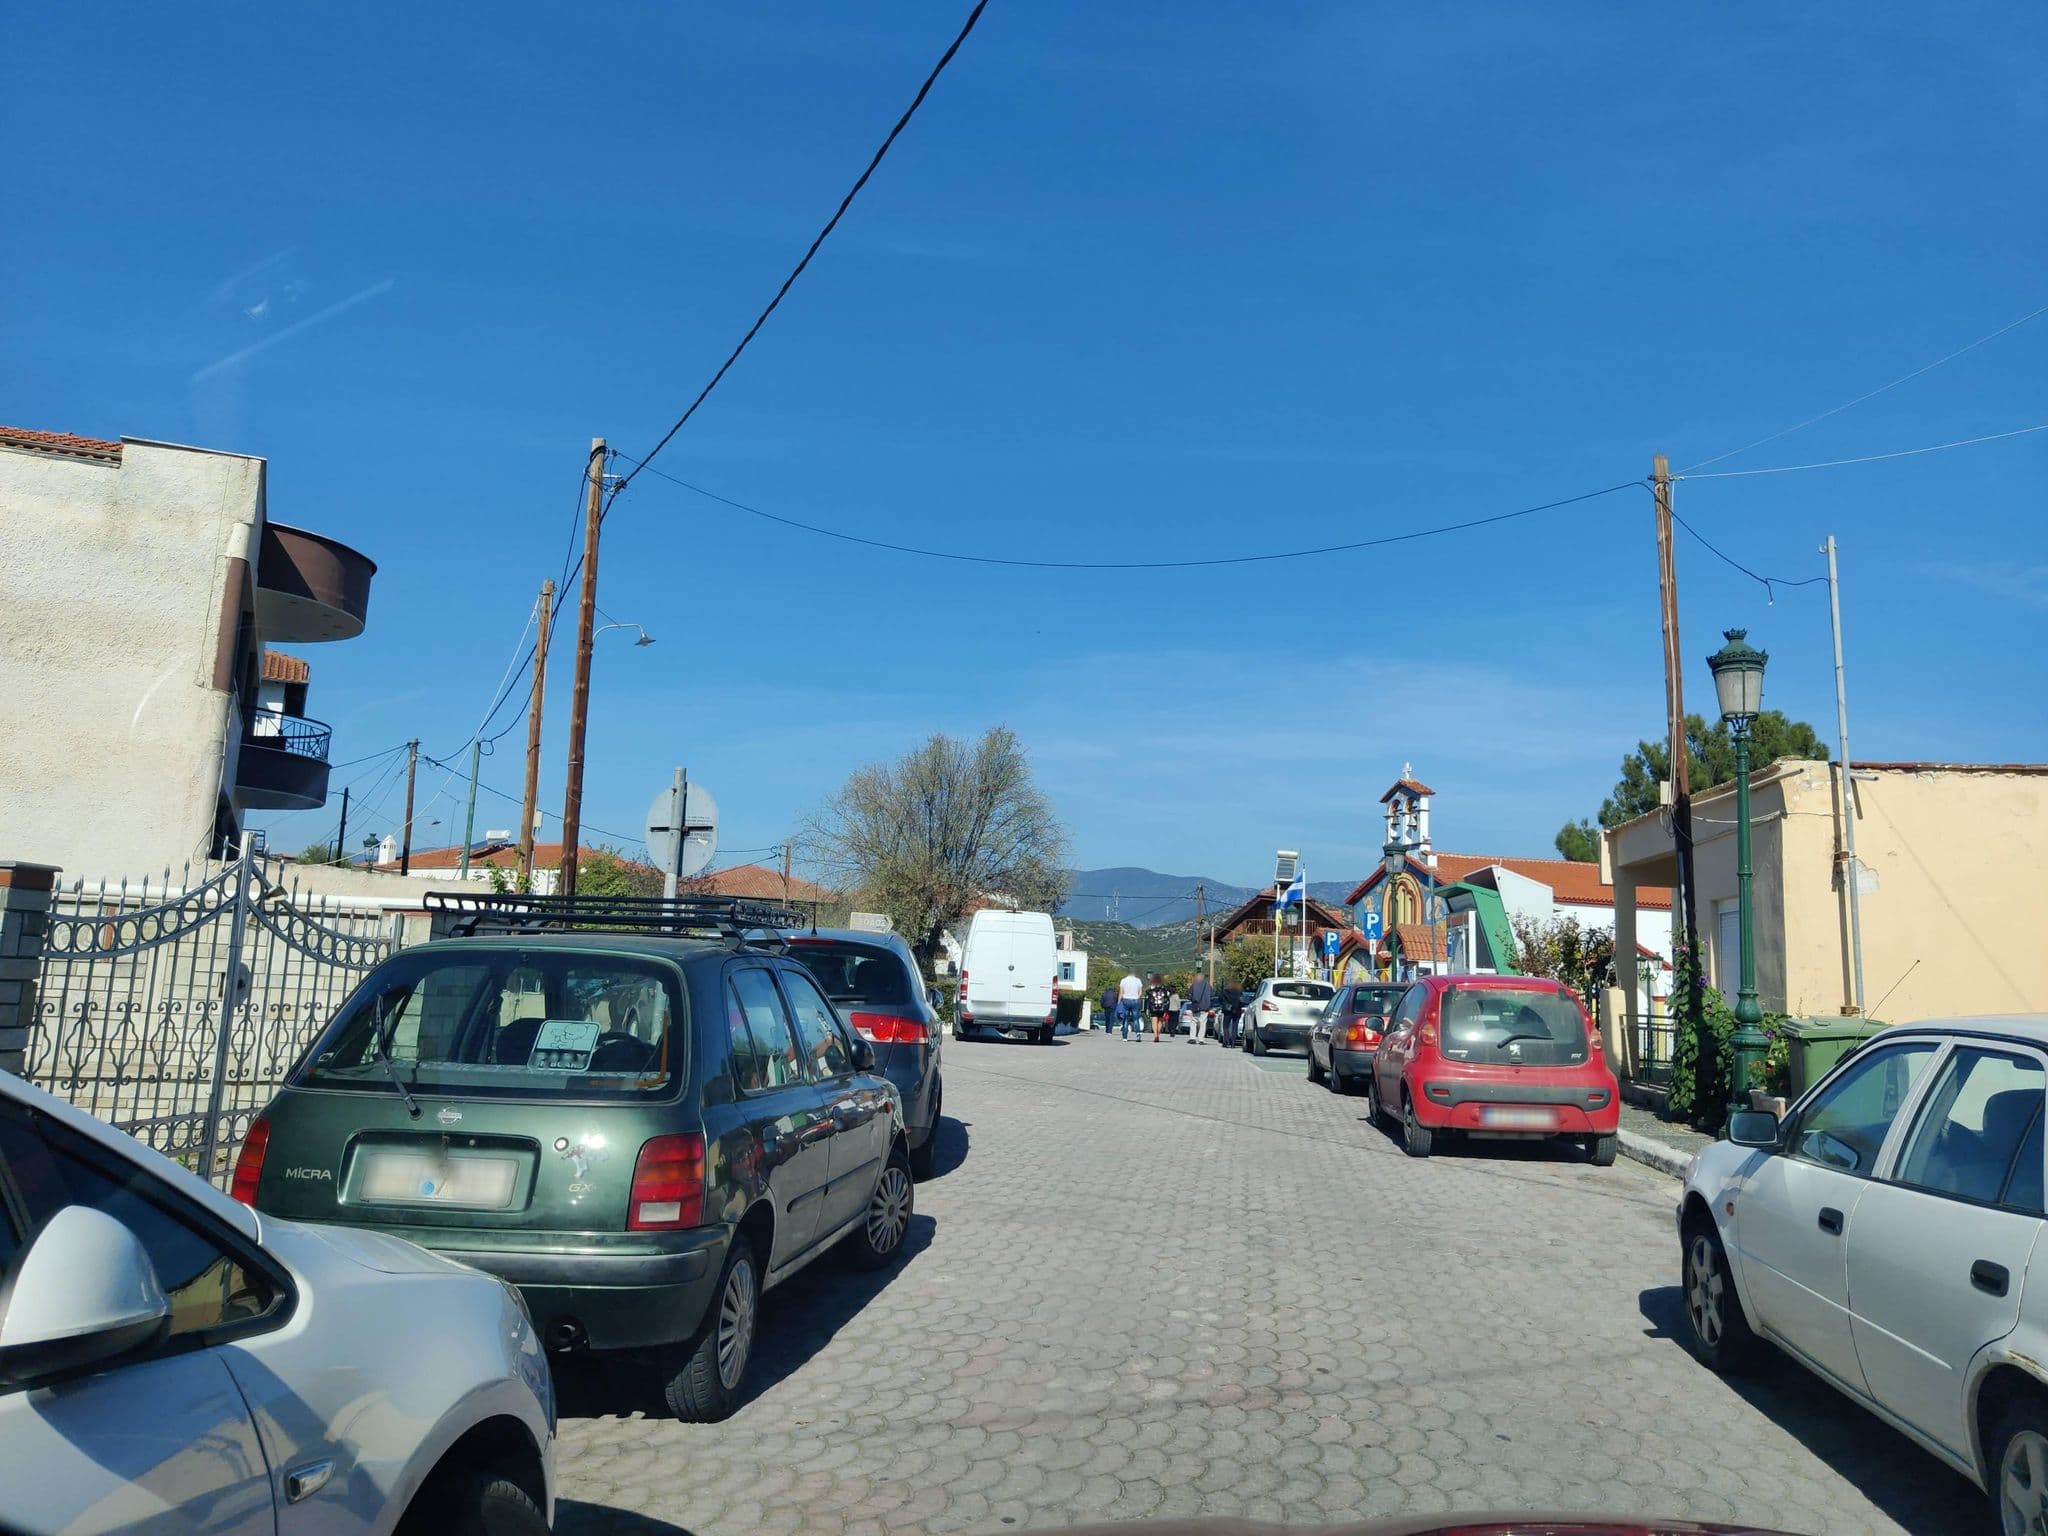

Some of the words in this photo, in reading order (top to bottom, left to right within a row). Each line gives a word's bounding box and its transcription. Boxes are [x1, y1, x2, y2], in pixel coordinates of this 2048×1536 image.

[1367, 913, 1380, 930] P
[1327, 932, 1338, 946] P
[285, 1167, 332, 1181] MICRA
